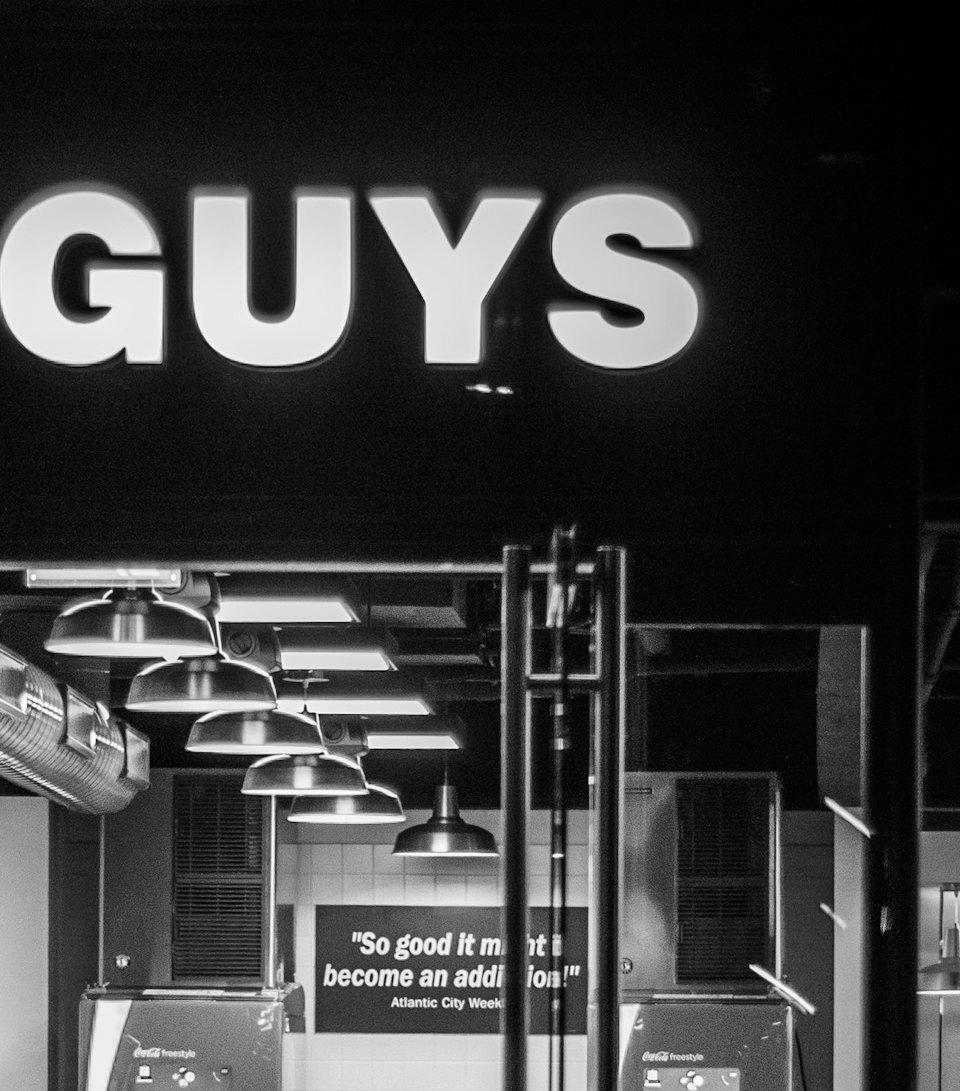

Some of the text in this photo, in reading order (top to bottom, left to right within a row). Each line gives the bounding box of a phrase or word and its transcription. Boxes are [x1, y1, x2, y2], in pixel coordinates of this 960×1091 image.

[351, 931, 547, 961] "So good it mht
[323, 963, 414, 988] become
[419, 968, 449, 988] an
[391, 997, 438, 1009] Atlantic
[441, 997, 466, 1011] City
[670, 1052, 704, 1062] freestyle
